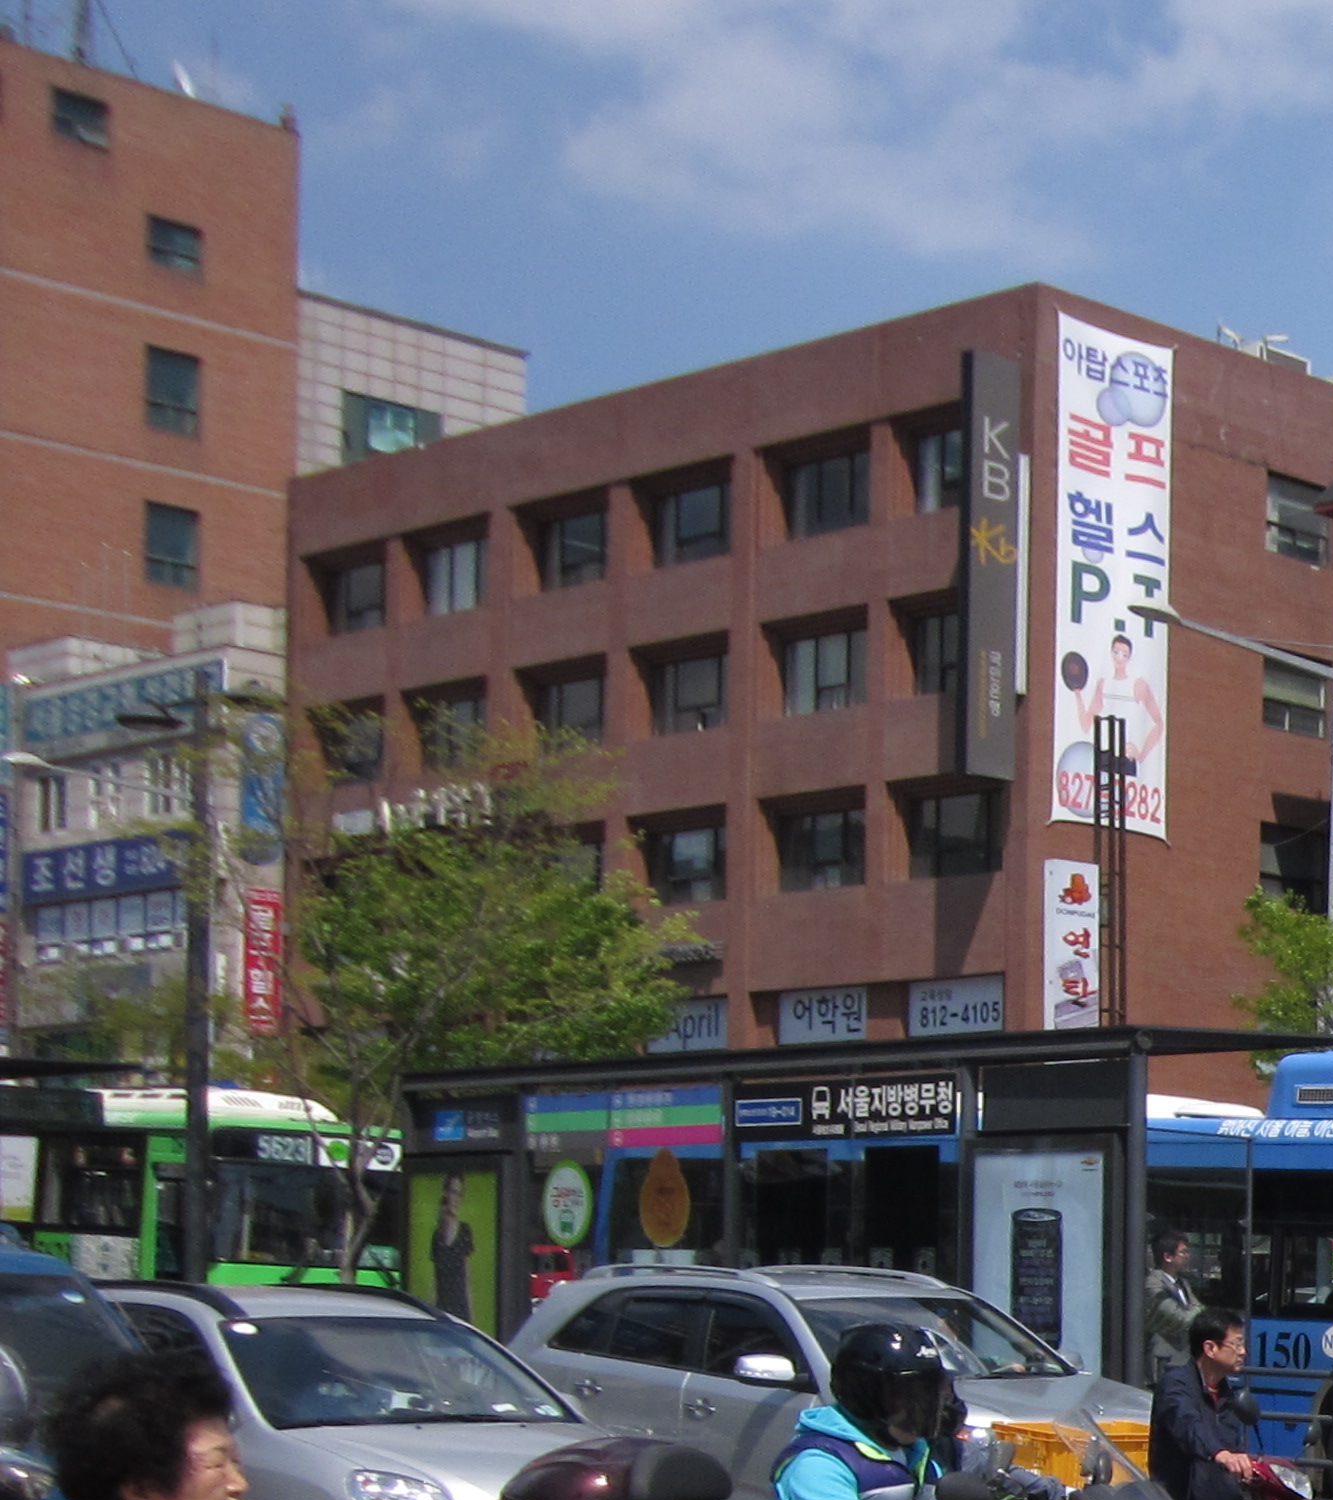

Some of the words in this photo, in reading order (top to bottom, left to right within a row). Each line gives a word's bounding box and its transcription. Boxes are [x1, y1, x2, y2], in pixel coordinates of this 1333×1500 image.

[983, 416, 1011, 501] KB
[1066, 490, 1167, 566] 헬스
[1057, 770, 1163, 824] 827-282
[669, 1003, 720, 1050] April
[793, 994, 862, 1034] 어학원
[919, 1001, 1001, 1030] 812-4105
[837, 1081, 953, 1119] 서울지방병무청
[1257, 1331, 1311, 1369] 150
